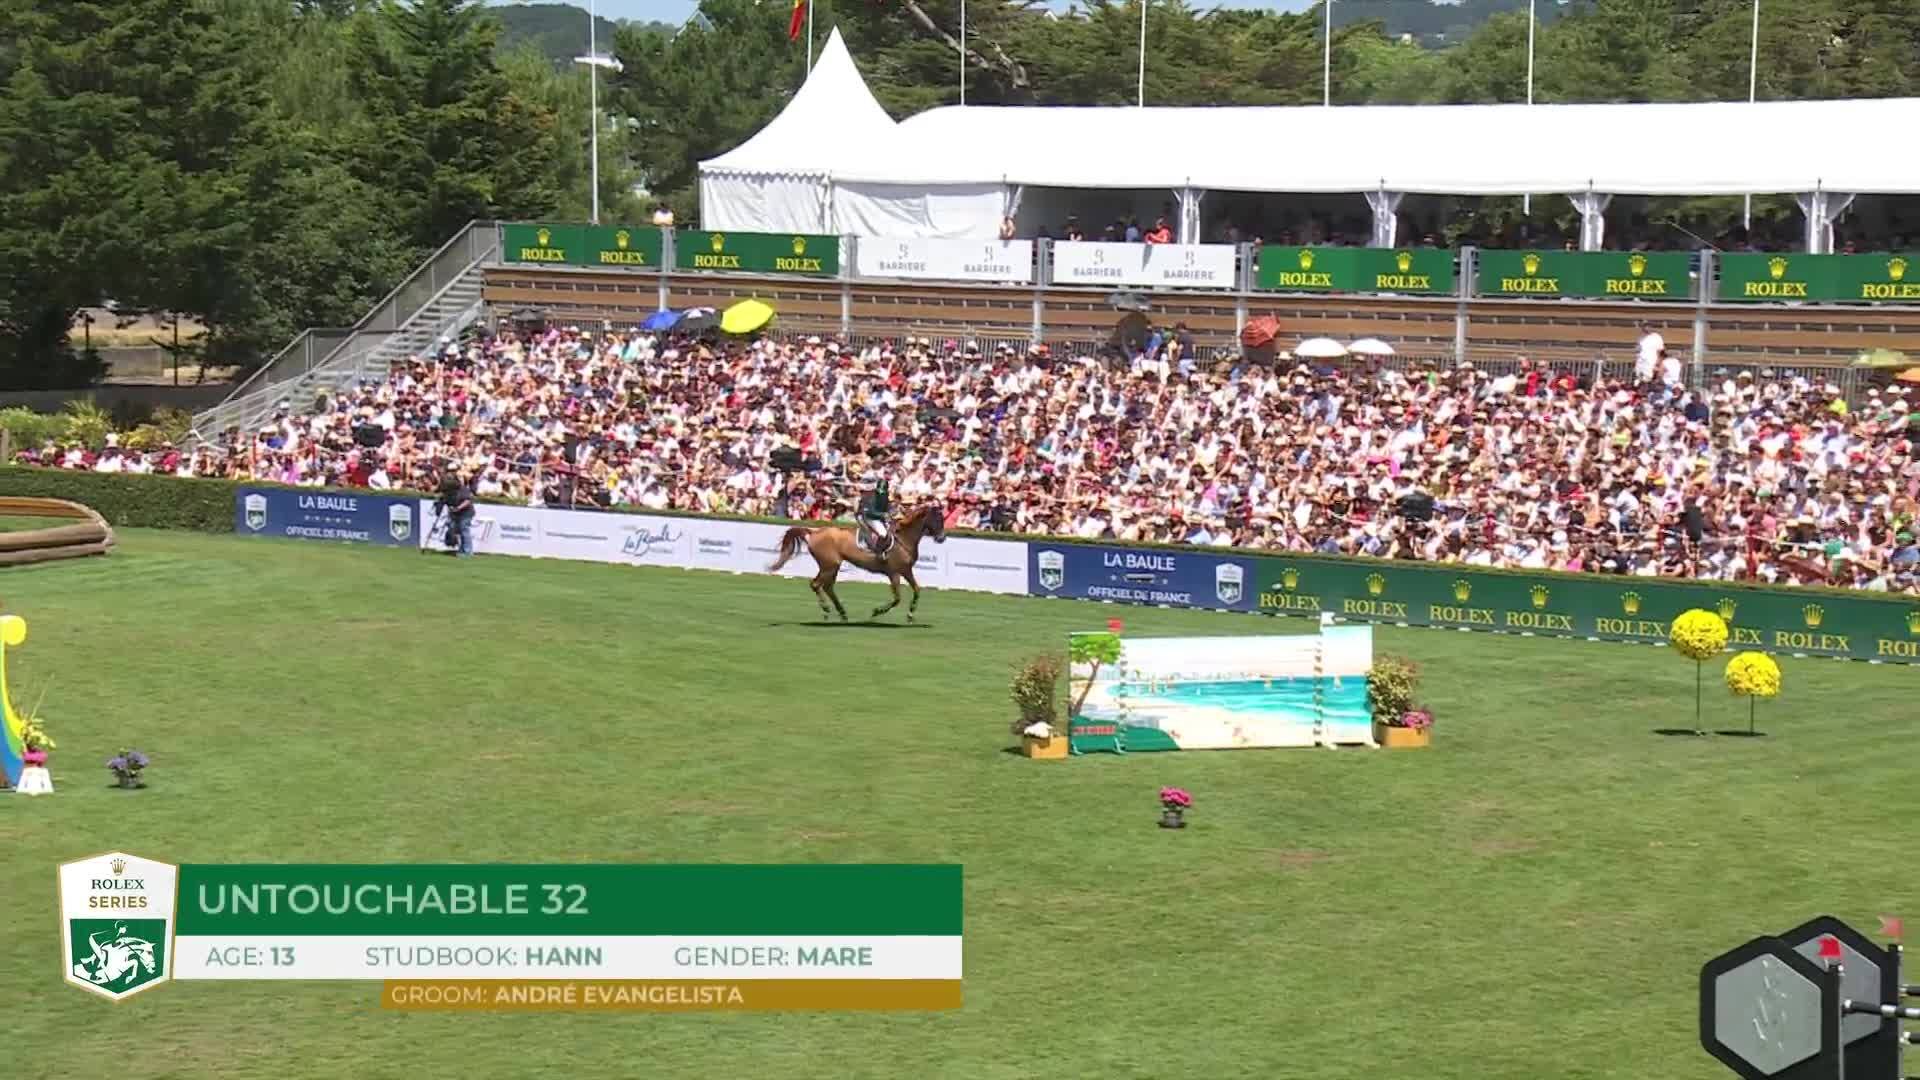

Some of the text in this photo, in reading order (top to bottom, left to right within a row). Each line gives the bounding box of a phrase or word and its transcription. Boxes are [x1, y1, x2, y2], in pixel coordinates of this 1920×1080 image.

[521, 248, 565, 262] ROLEX
[600, 251, 645, 265] ROLEX
[695, 255, 741, 268] ROLEX
[776, 257, 821, 271] ROLEX
[1280, 272, 1332, 287] ROLEX
[1376, 275, 1430, 289] ROLEX
[1502, 278, 1559, 293] ROLEX
[1606, 280, 1666, 294] ROLEX
[1744, 282, 1808, 297] ROLEX
[1863, 284, 1920, 298] ROLE
[299, 495, 358, 512] LA BAULE
[336, 529, 370, 541] FRANCE
[1104, 552, 1176, 571] LA BAULE
[1088, 585, 1192, 604] OFFICIEL DE FRANCE
[1259, 593, 1322, 611] ROLEX
[1344, 599, 1408, 617] ROLEX
[1429, 605, 1495, 625] ROLEX
[1506, 611, 1574, 631] ROLEX
[1596, 618, 1666, 637] ROLEX
[1775, 631, 1850, 650] ROLEX
